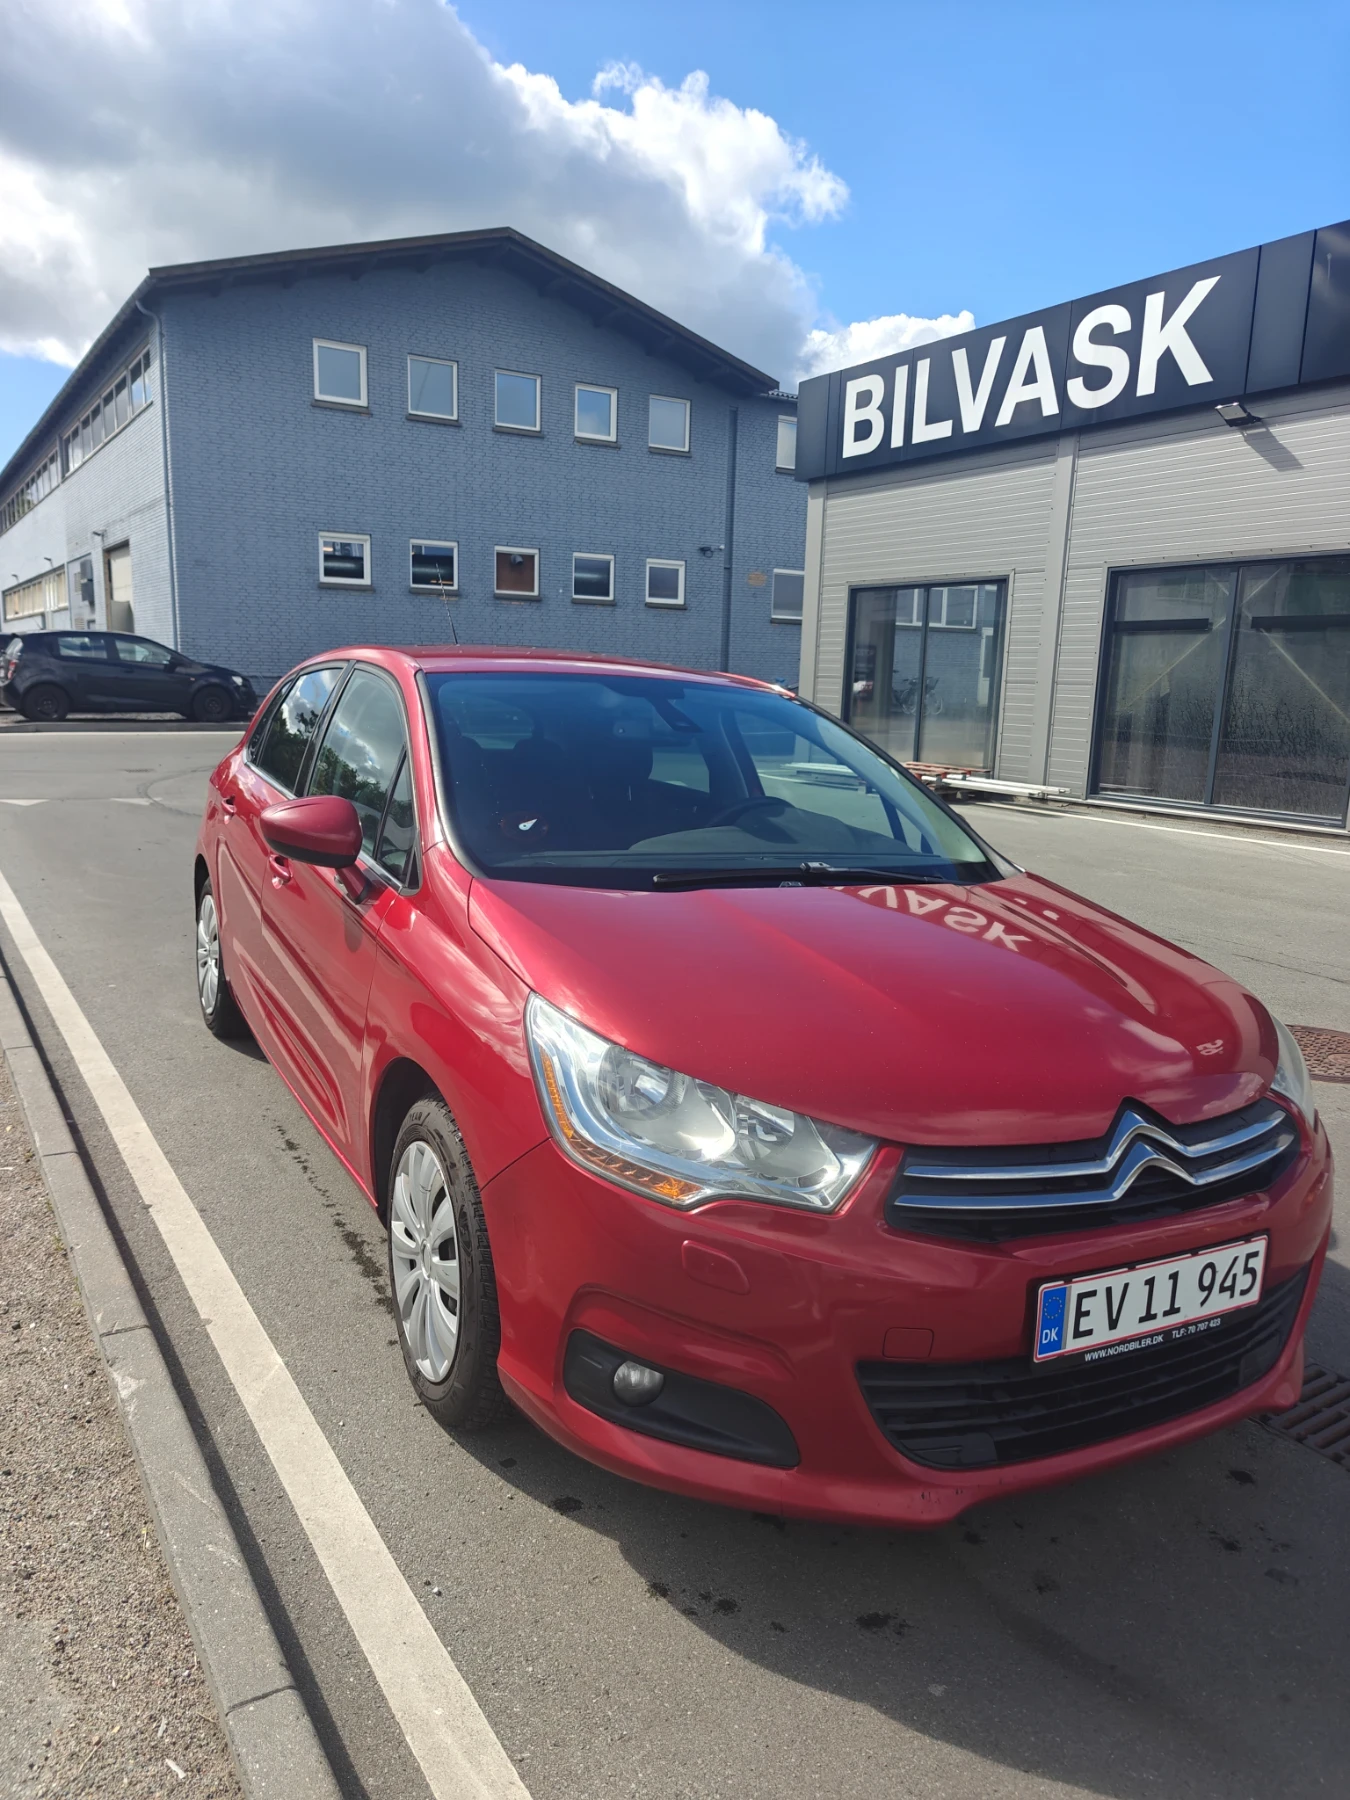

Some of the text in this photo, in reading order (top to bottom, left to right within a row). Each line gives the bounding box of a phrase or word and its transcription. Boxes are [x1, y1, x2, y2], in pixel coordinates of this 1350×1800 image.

[842, 275, 1221, 458] BILVASK
[1072, 1250, 1260, 1340] EV 11 945
[1042, 1327, 1058, 1344] DK
[1084, 1334, 1164, 1362] WWW.NORDBILER.DK
[1172, 1328, 1187, 1339] TLF:
[1187, 1325, 1196, 1334] 70
[1197, 1321, 1208, 1331] 707
